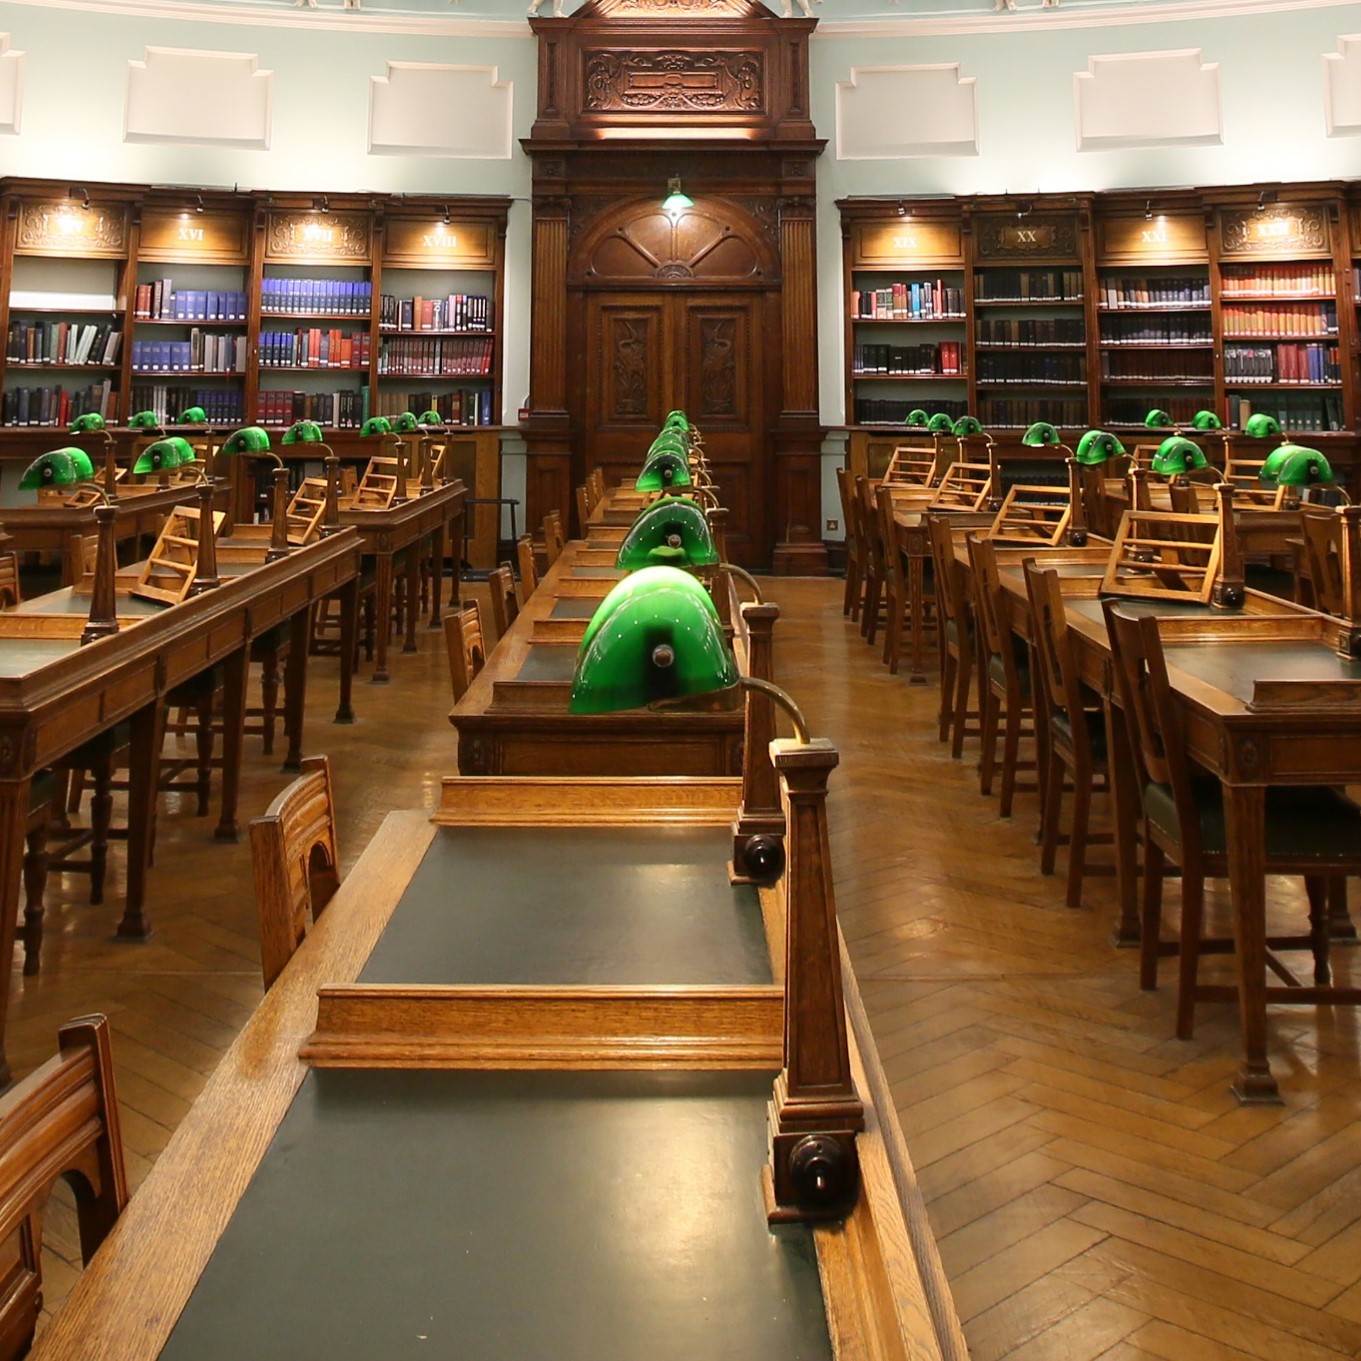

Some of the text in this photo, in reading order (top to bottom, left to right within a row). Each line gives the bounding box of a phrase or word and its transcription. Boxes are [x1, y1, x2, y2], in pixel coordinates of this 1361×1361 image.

[178, 228, 204, 241] XVI
[1017, 231, 1037, 243] XX
[1141, 231, 1167, 243] XXI
[423, 235, 457, 248] XVIII
[893, 236, 917, 249] XIX
